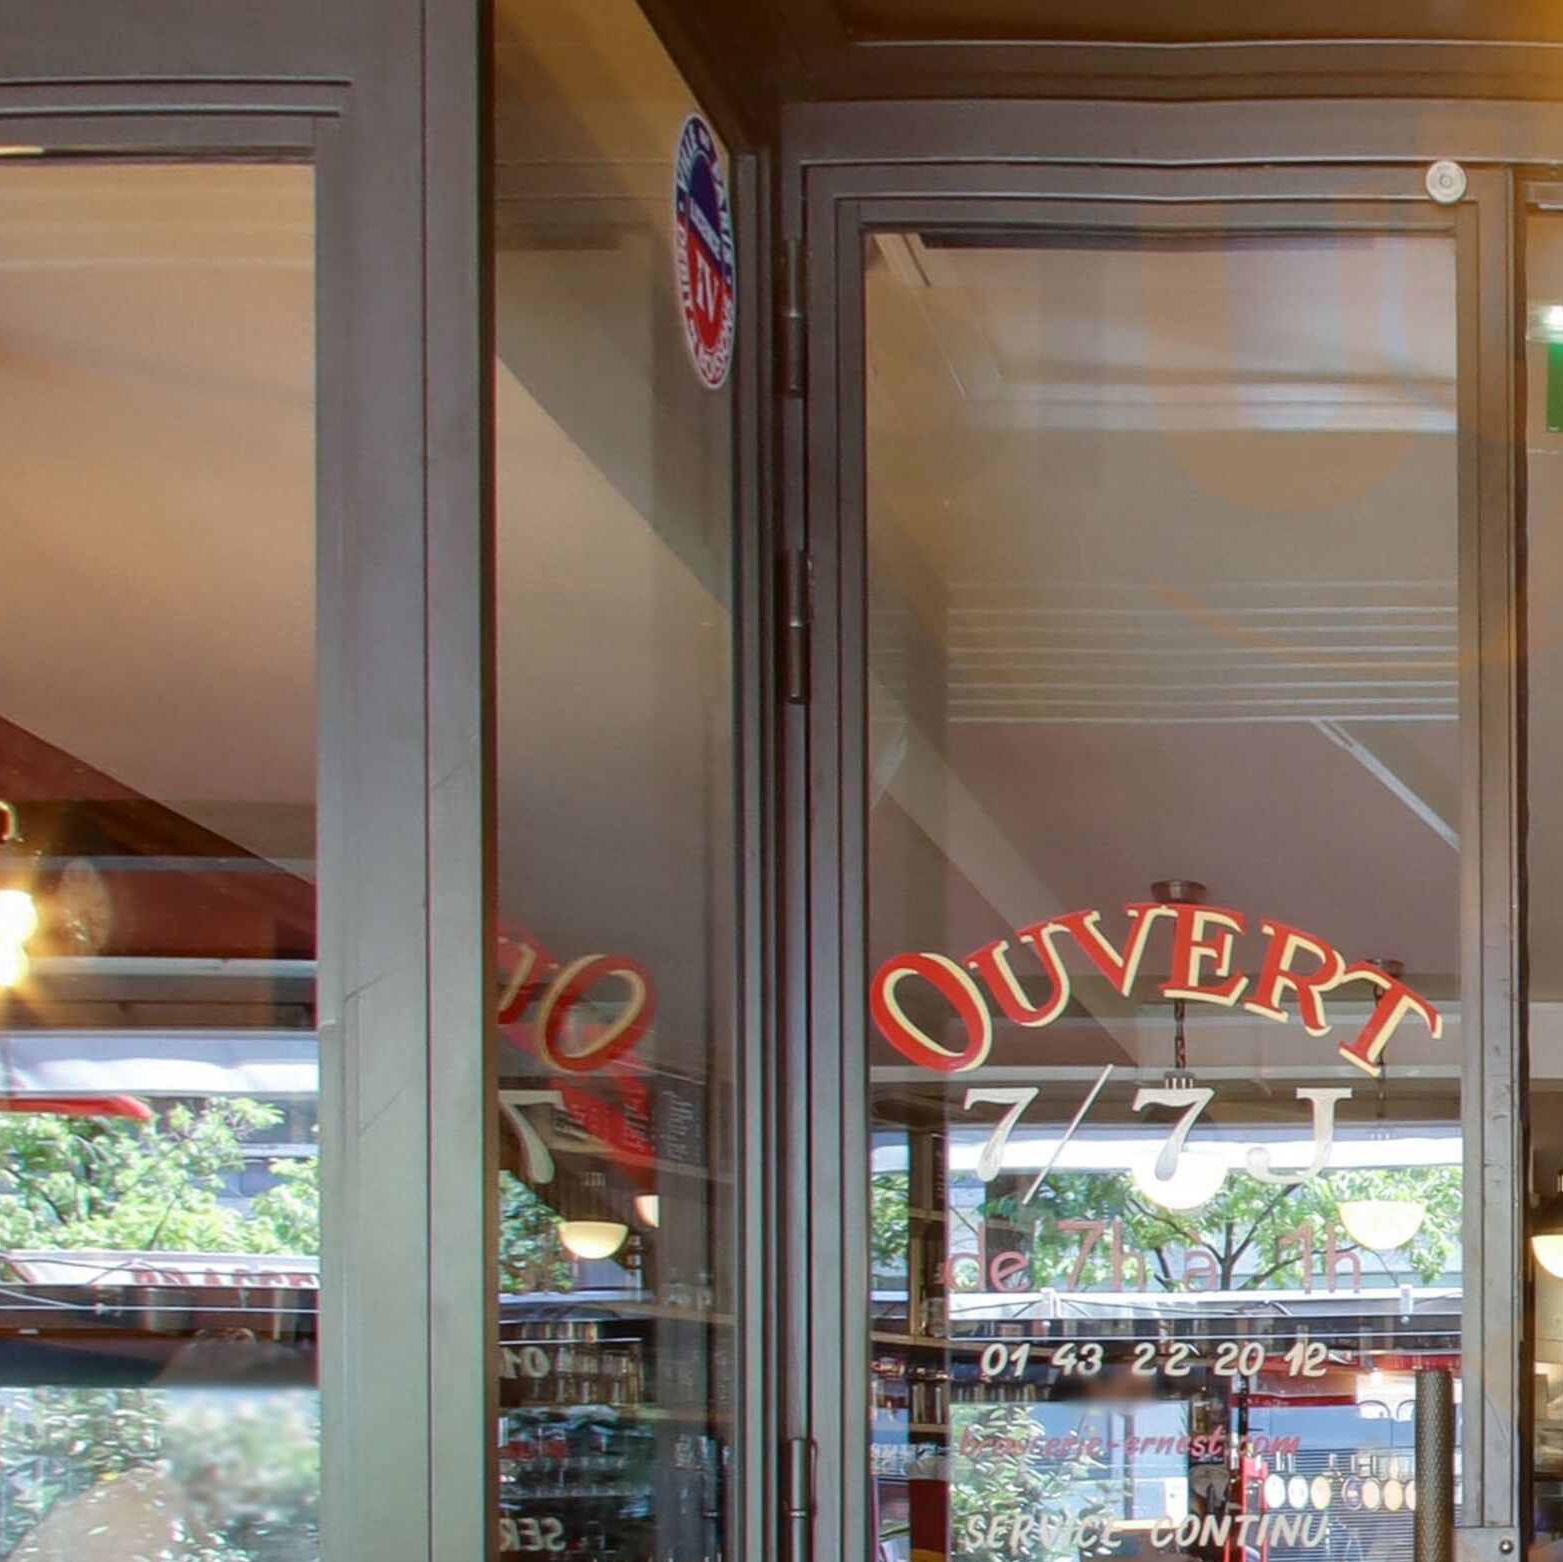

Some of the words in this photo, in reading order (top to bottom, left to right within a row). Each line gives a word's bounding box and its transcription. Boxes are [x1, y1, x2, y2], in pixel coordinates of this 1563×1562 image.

[869, 902, 1443, 1077] OUVERT
[979, 1342, 1029, 1378] 01
[1050, 1341, 1104, 1376] 43
[1130, 1342, 1191, 1377] 22
[1214, 1342, 1266, 1377] 20
[1284, 1342, 1329, 1379] 12
[964, 1513, 1126, 1552] SERVICE
[1149, 1514, 1330, 1550] CONTINU
